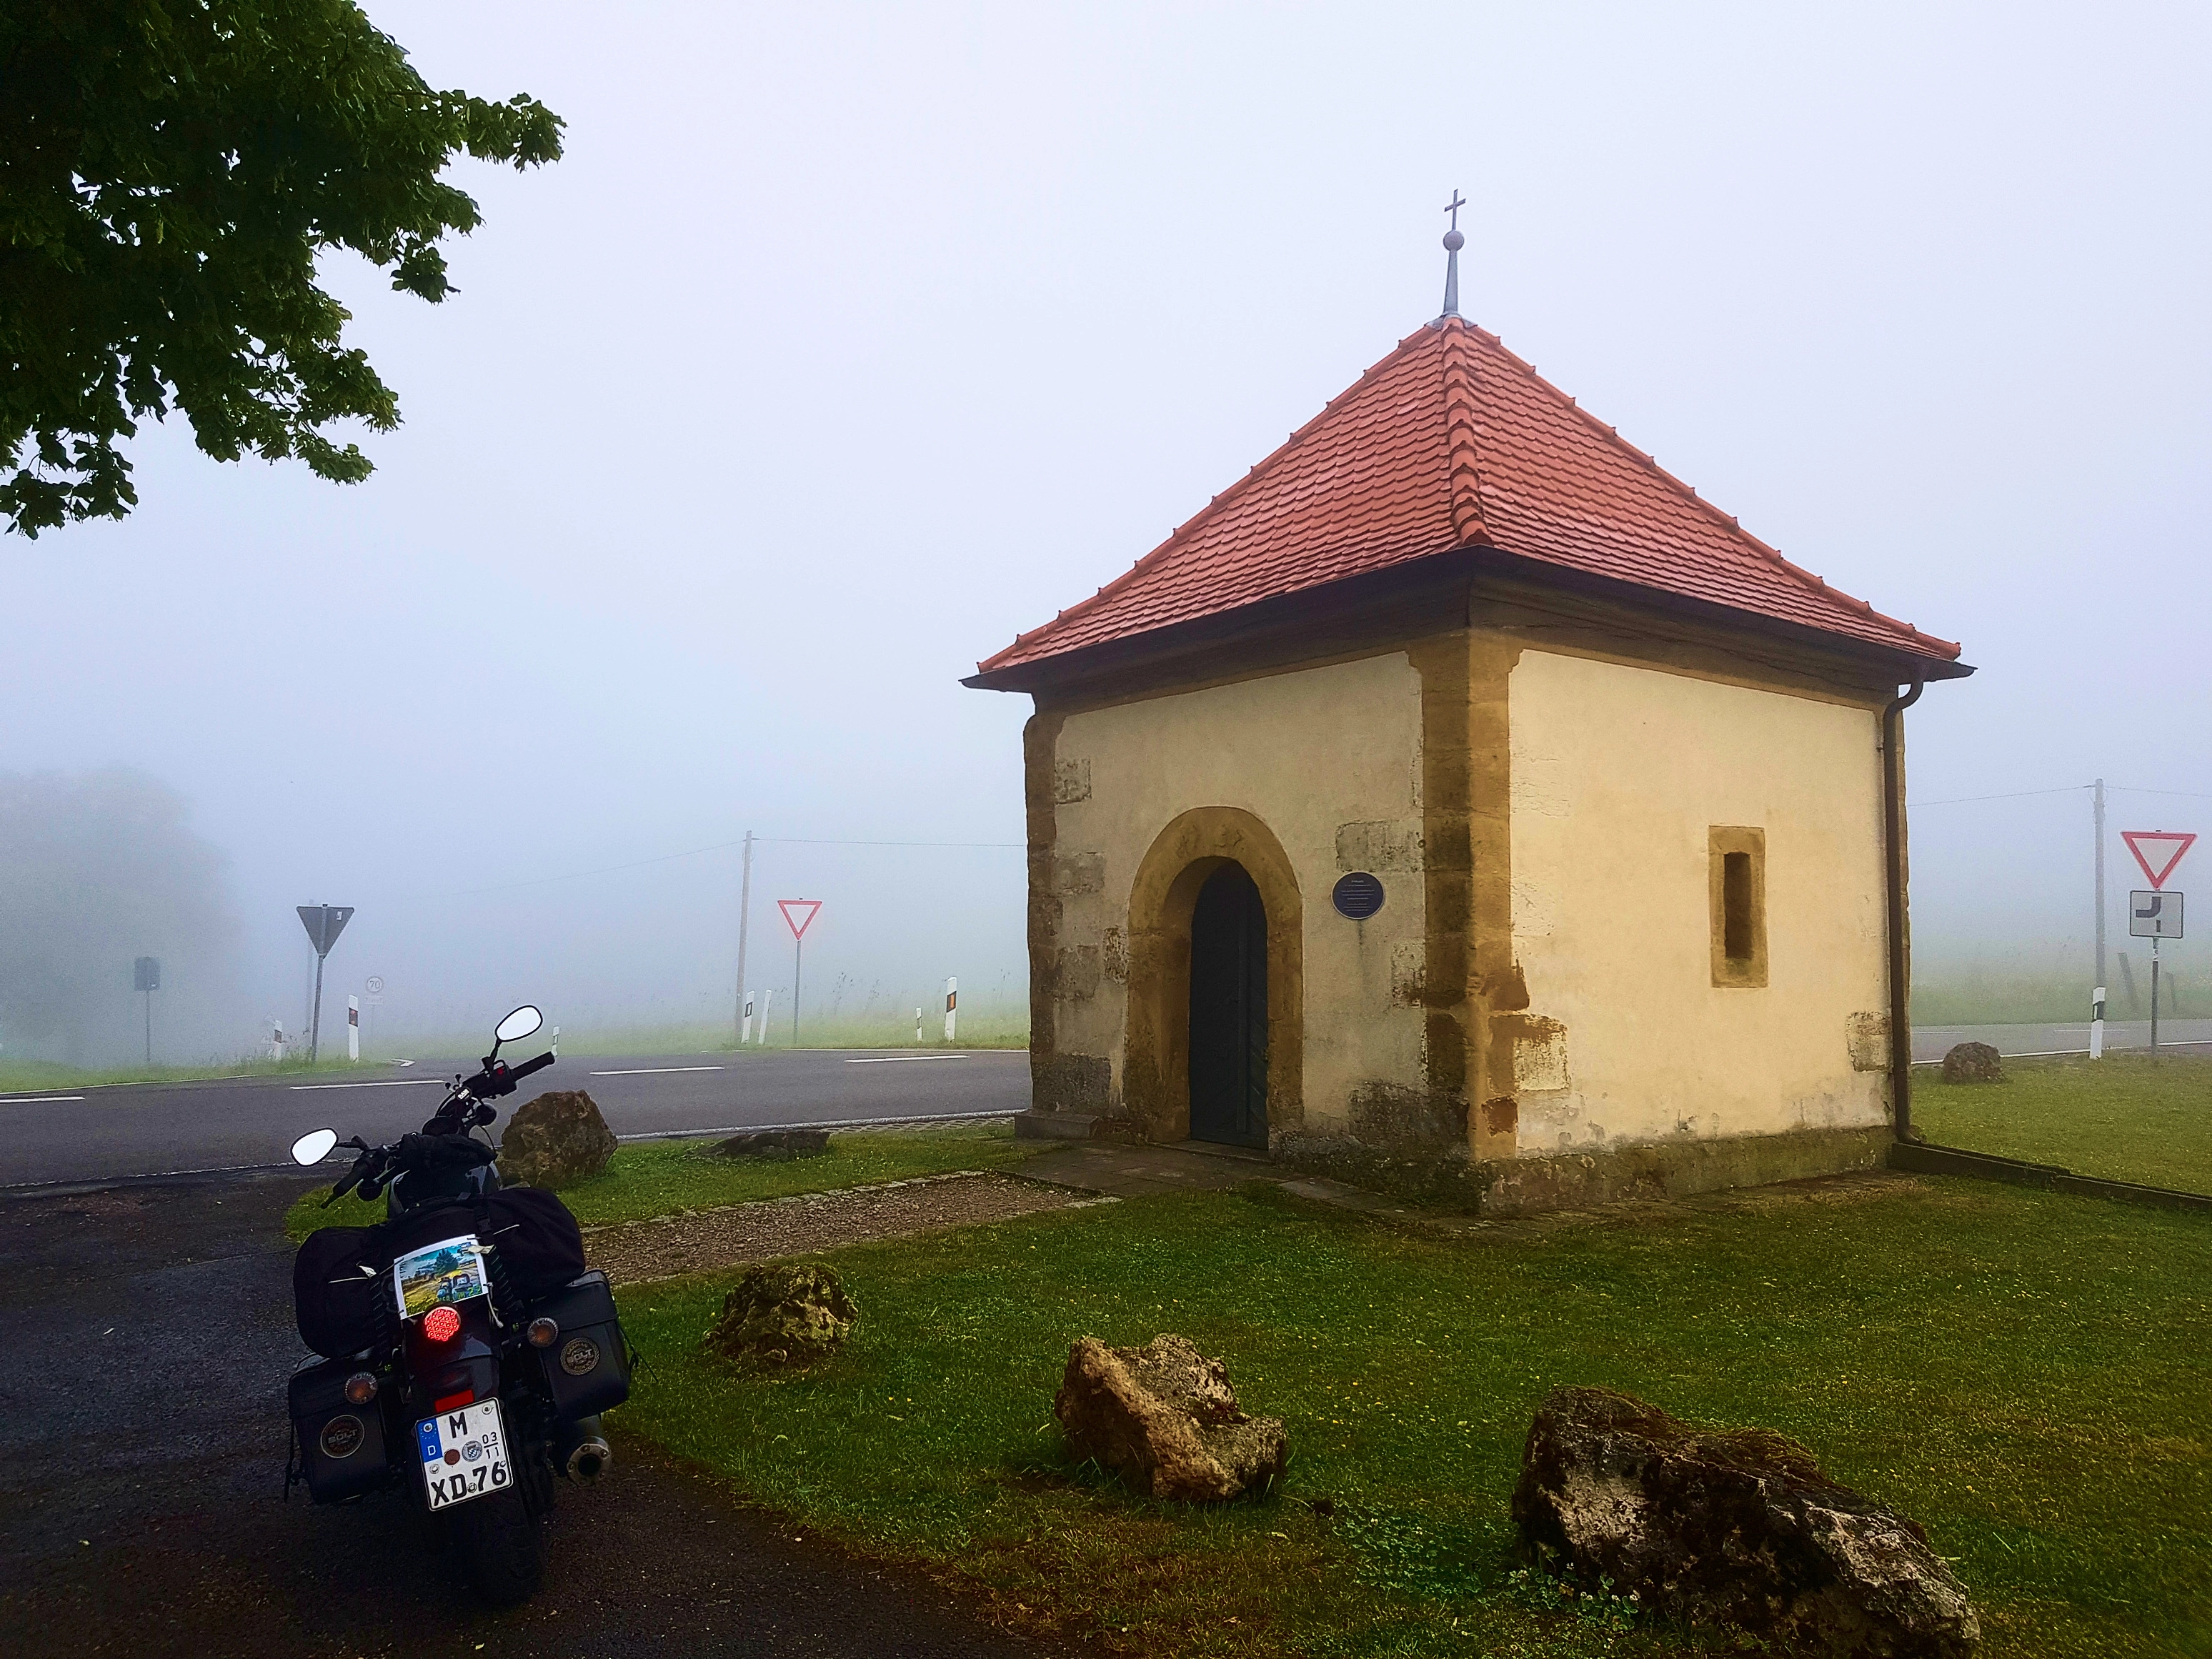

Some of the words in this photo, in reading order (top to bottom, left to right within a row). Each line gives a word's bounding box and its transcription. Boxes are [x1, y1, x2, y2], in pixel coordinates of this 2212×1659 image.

[369, 980, 380, 989] 70
[449, 1411, 468, 1439] M
[482, 1431, 497, 1444] 03
[427, 1445, 436, 1456] D
[486, 1446, 499, 1460] 11
